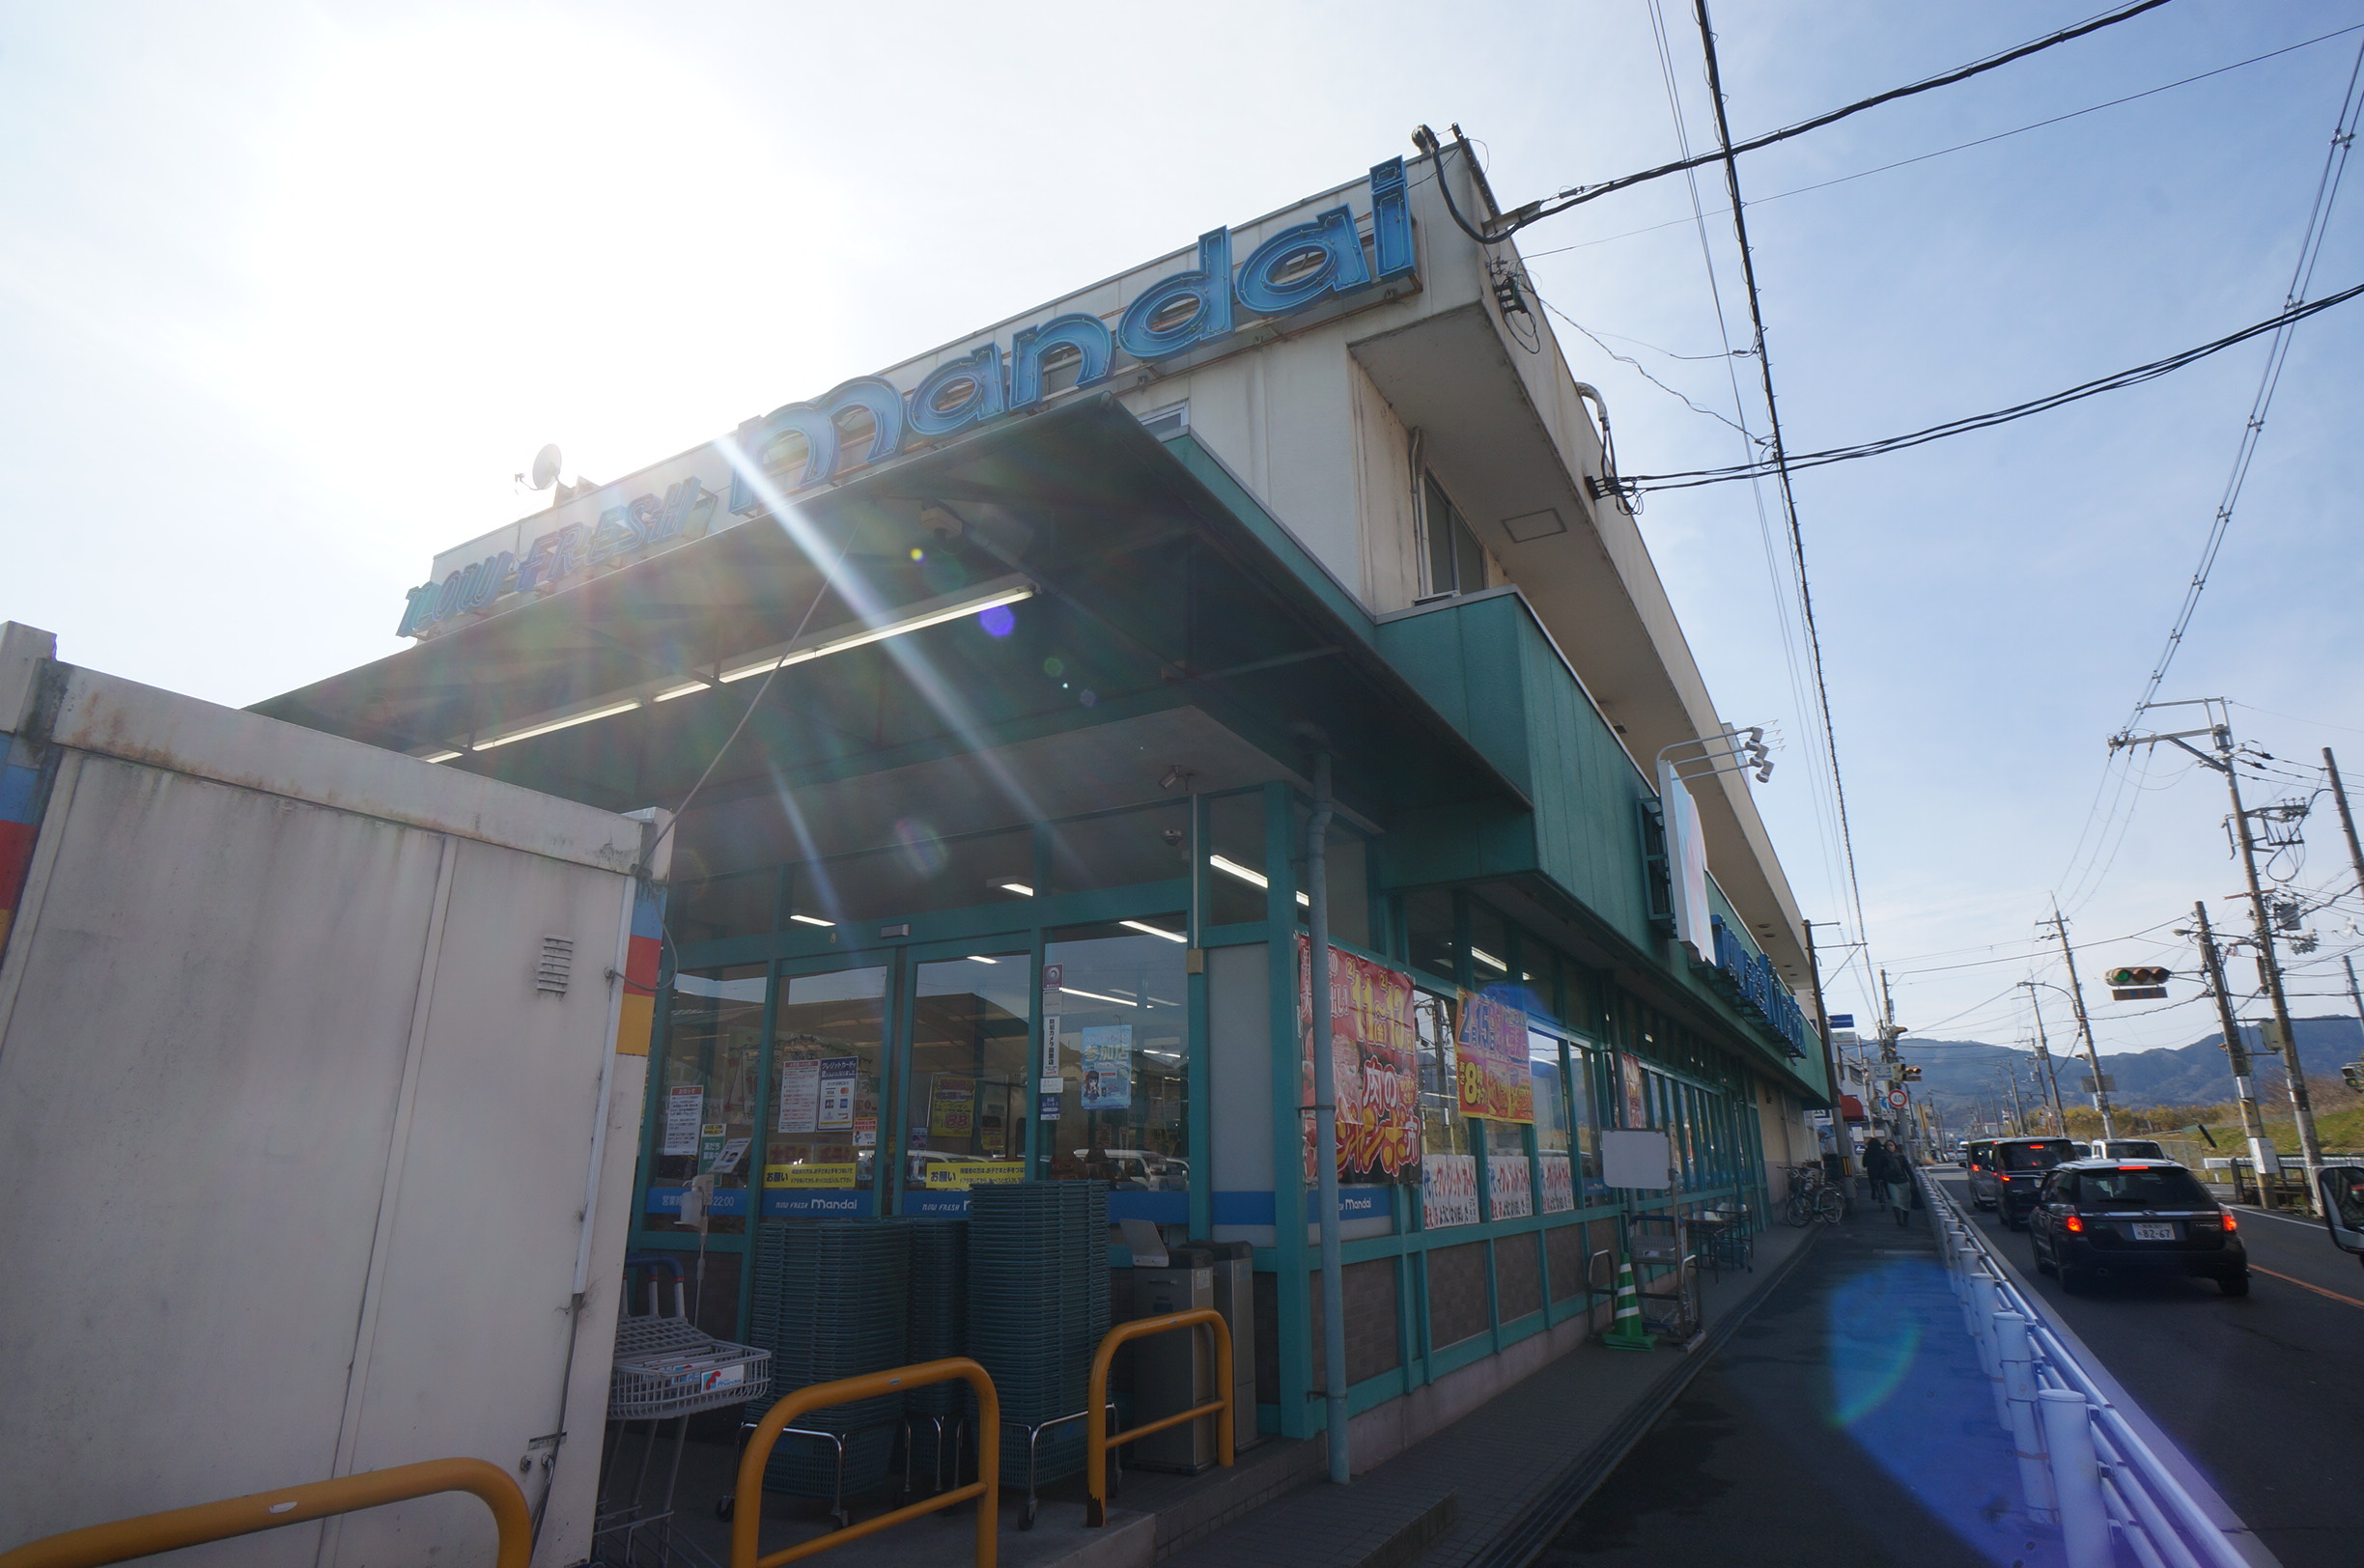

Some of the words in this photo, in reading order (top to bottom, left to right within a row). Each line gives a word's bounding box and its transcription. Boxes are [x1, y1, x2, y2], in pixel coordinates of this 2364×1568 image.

[516, 476, 702, 592] FRESH
[727, 155, 1416, 516] mandai
[1084, 1043, 1130, 1062] 参加店
[1363, 1062, 1397, 1110] 肉の
[1893, 1094, 1903, 1103] 40
[766, 1172, 788, 1182] お願い
[930, 1171, 956, 1183] お願い
[713, 1196, 735, 1207] 22:00
[939, 1203, 960, 1212] FRESH
[2143, 1229, 2171, 1239] 82-67
